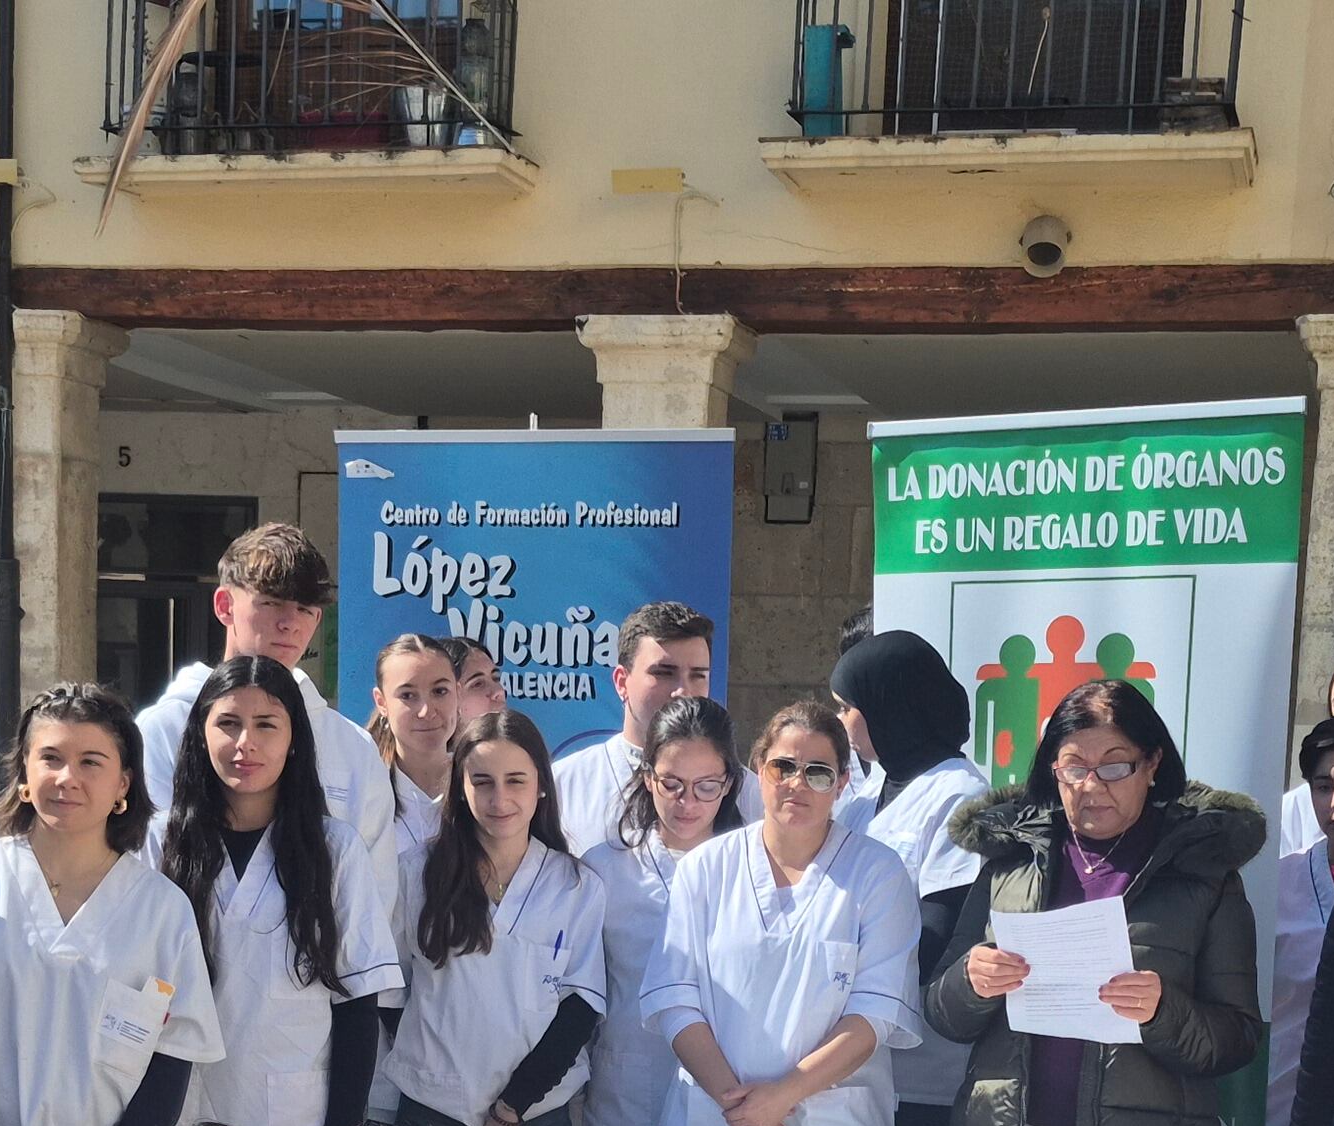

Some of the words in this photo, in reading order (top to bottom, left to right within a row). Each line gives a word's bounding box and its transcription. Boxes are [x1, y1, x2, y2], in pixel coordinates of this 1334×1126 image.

[118, 445, 132, 468] 5
[887, 466, 922, 503] LA
[928, 449, 1077, 500] DONACIÓN
[1084, 454, 1125, 492] DE
[1131, 444, 1287, 490] ÓRGANOS
[380, 501, 440, 526] Centro
[447, 501, 468, 525] de
[475, 500, 567, 527] Formación
[575, 502, 680, 527] Profesional
[915, 519, 948, 554] ES
[955, 517, 996, 552] UN
[1003, 512, 1118, 551] REGALO
[1126, 509, 1166, 547] DE
[1173, 507, 1248, 544] VIDA
[372, 531, 516, 614] López
[447, 600, 620, 669] Vicuña
[500, 672, 596, 700] ALENCIA
